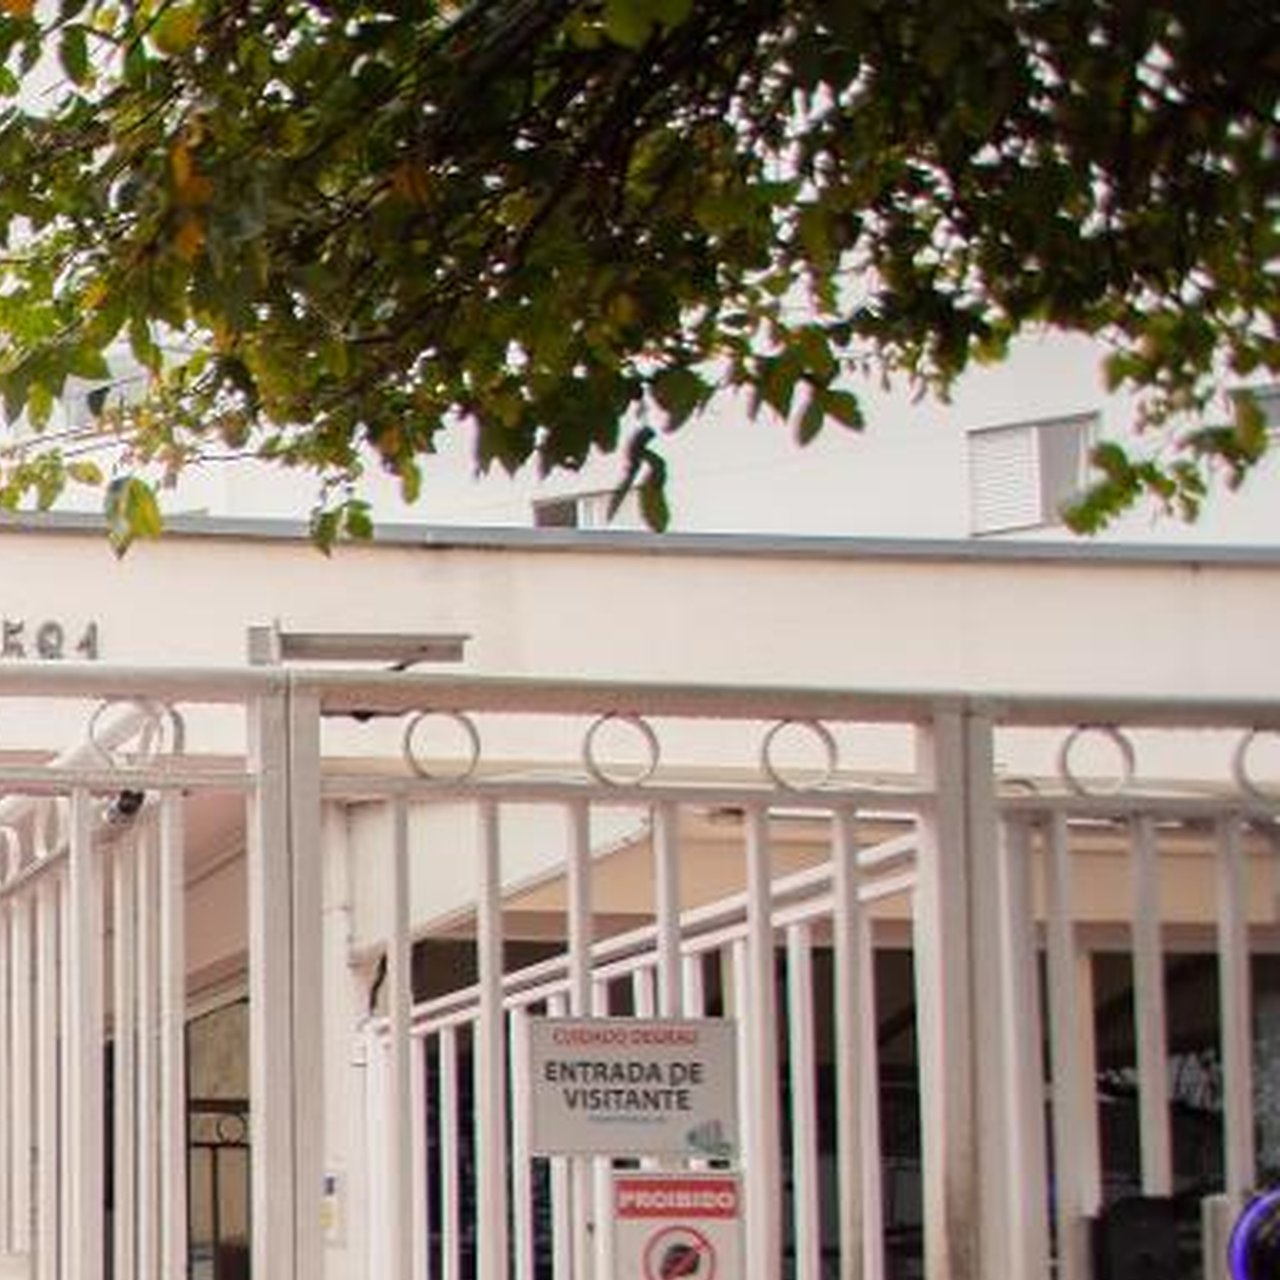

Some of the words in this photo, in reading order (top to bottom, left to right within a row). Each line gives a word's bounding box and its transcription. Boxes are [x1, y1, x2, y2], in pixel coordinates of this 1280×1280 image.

[544, 1061, 662, 1084] ENTRADA
[669, 1062, 705, 1086] DE
[564, 1089, 693, 1111] VISITANTE
[617, 1191, 734, 1209] PROIBIDO
